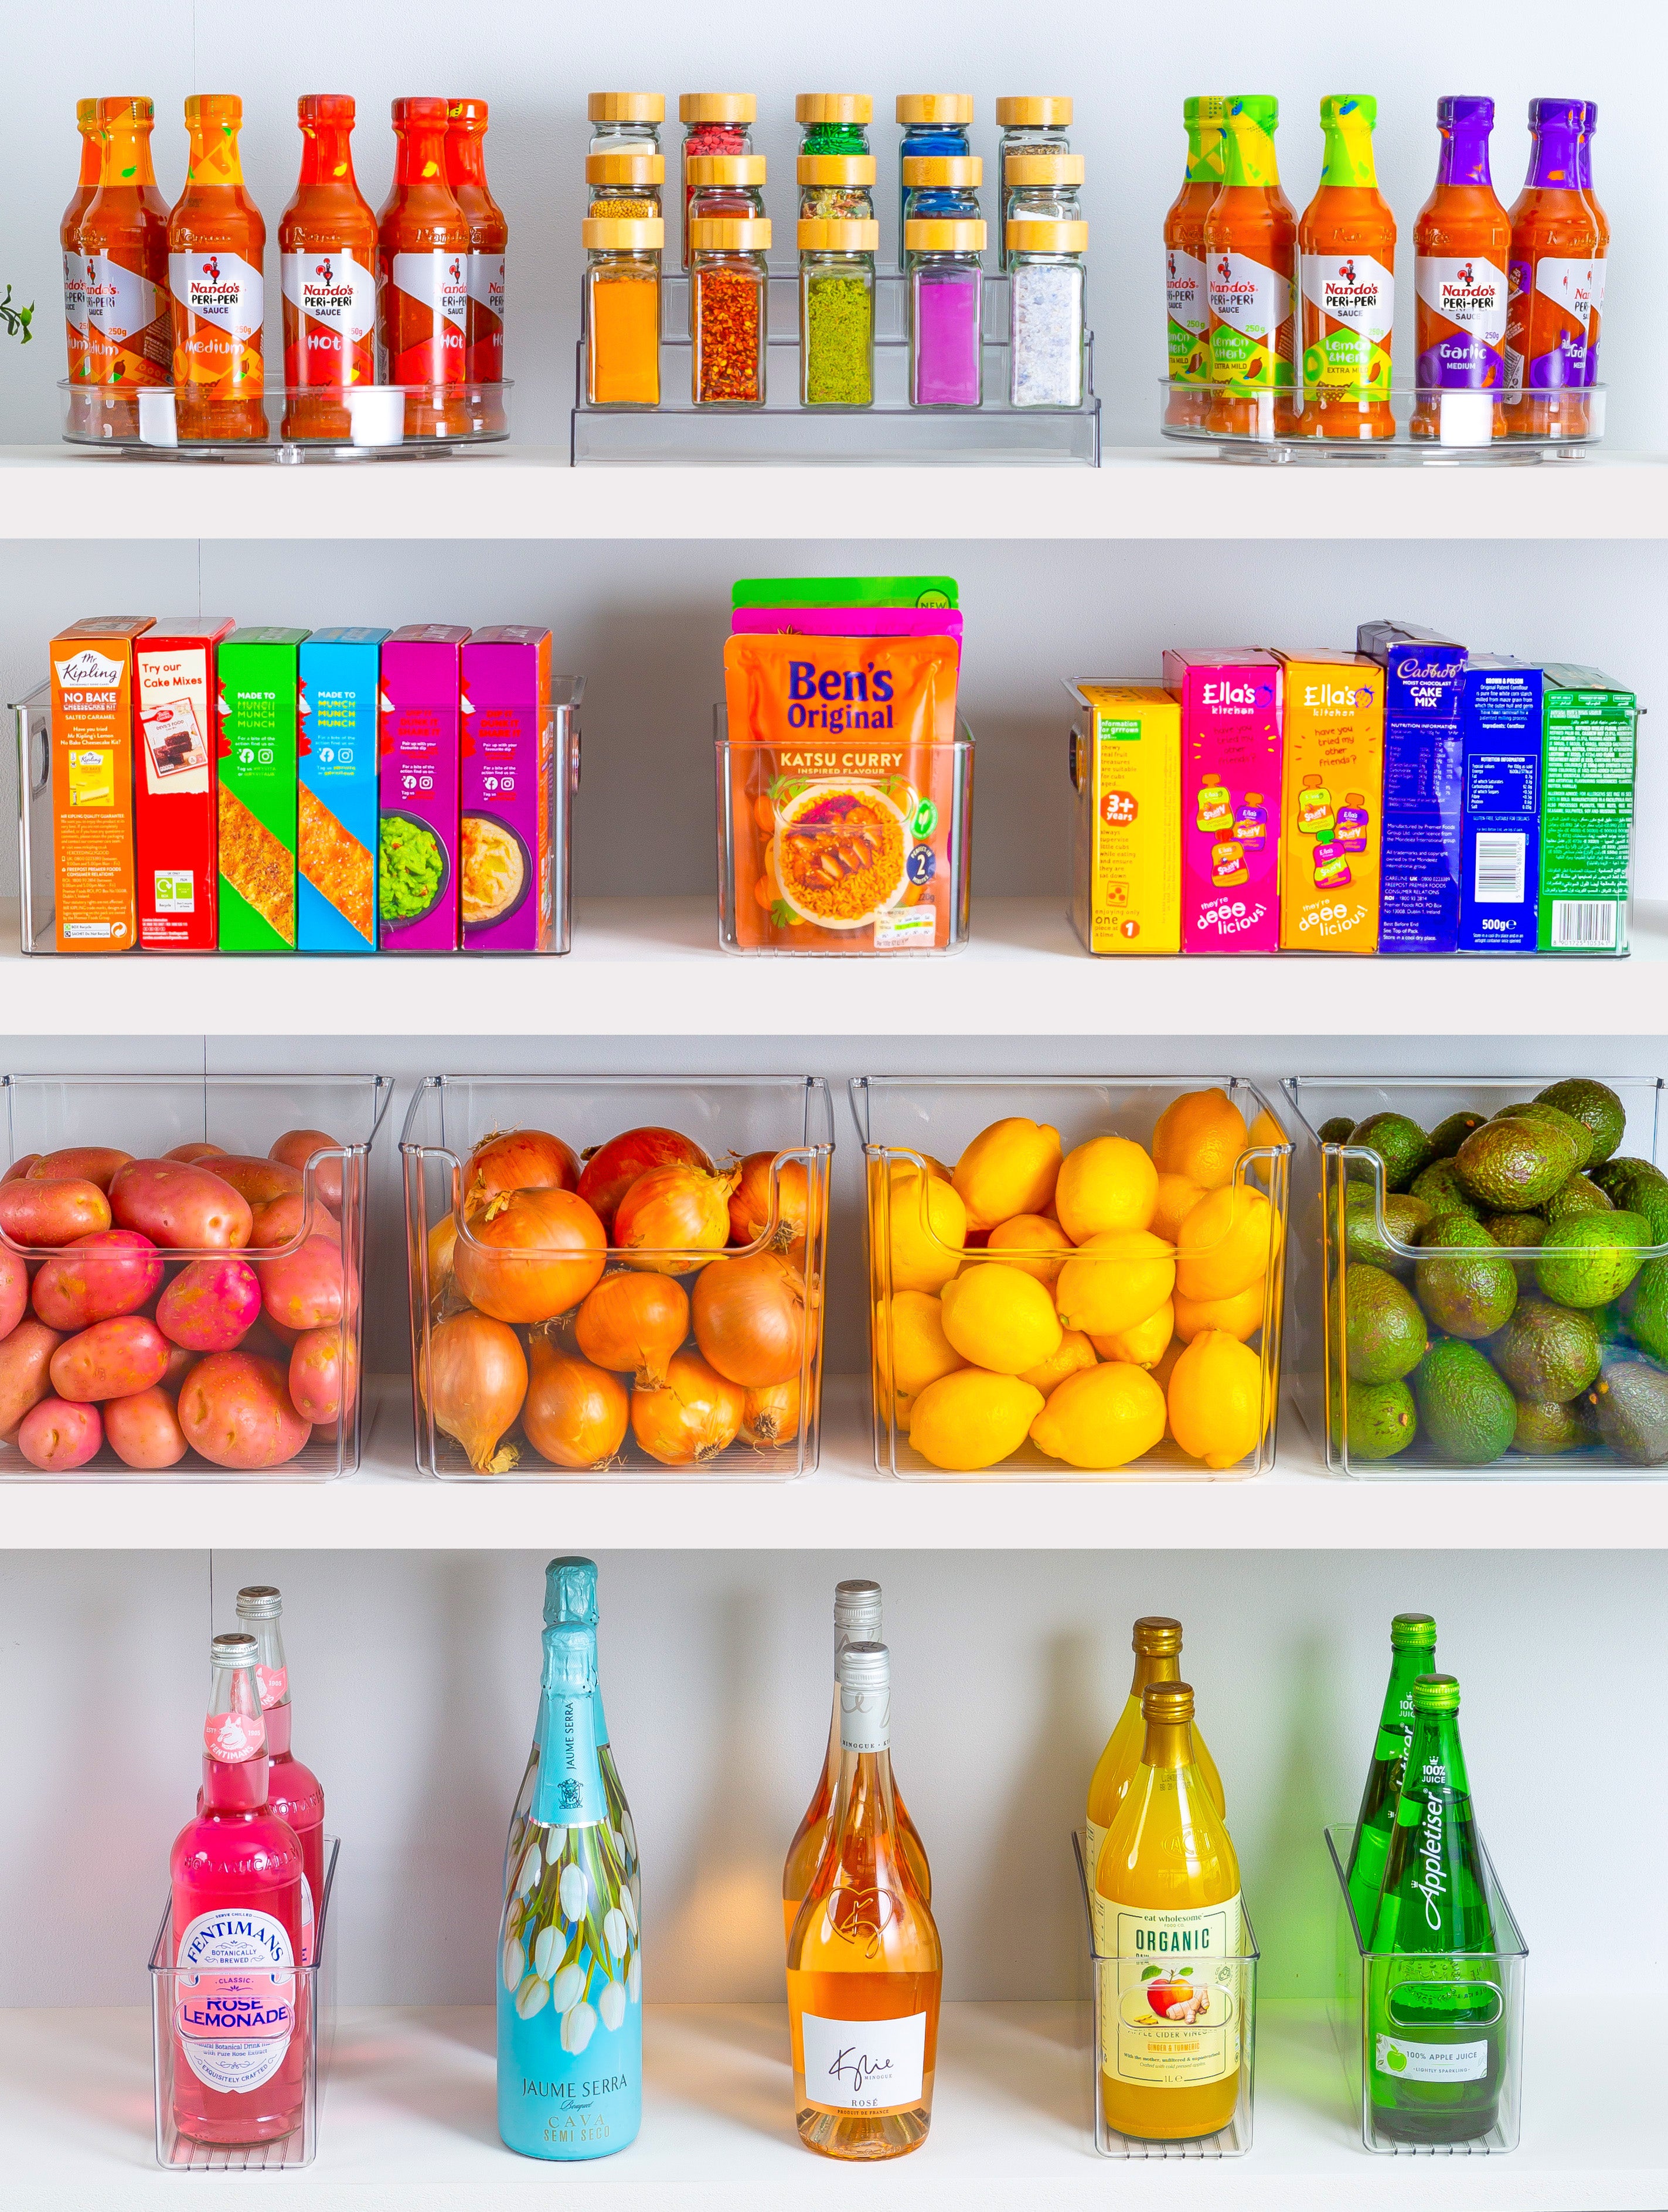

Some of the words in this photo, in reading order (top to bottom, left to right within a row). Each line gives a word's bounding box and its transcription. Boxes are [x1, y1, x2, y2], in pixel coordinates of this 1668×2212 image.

[190, 282, 240, 294] Nando's
[303, 284, 354, 296] Nando's
[1210, 282, 1256, 293] Nando's
[1325, 282, 1379, 295] Nando's
[1441, 285, 1496, 296] Nando's
[235, 326, 252, 335] 250g
[1186, 320, 1206, 329] 250g
[1245, 325, 1265, 334] 250g
[108, 327, 127, 337] 250g
[1369, 328, 1384, 337] 250g
[1485, 332, 1499, 340] 250g
[185, 339, 245, 355] Medium
[1213, 336, 1249, 347] Lemon
[1325, 339, 1371, 351] Lemon
[1439, 343, 1487, 359] Garlic
[81, 653, 97, 663] Mr
[62, 663, 117, 683] Kipling
[142, 664, 161, 674] Try
[163, 663, 182, 672] our
[144, 678, 170, 688] Cake
[173, 676, 202, 686] Mixes
[788, 661, 894, 702] Ben's
[64, 692, 83, 703] NO
[86, 692, 116, 703] BAKE
[1202, 681, 1256, 704] Ella's
[1303, 683, 1356, 707] Ella's
[1410, 687, 1442, 697] CAKE
[318, 700, 356, 708] MUNCH
[1415, 697, 1437, 707] MIX
[1211, 705, 1254, 715] kitchen
[1313, 708, 1355, 717] kitchen
[788, 703, 893, 734] Original
[1314, 728, 1336, 736] have
[1339, 726, 1353, 735] you
[1318, 737, 1340, 746] tried
[1342, 736, 1354, 745] my
[1325, 747, 1348, 755] other
[781, 752, 836, 766] KATSU
[842, 753, 903, 766] CURRY
[1319, 755, 1357, 767] friends?
[1107, 794, 1134, 813] 3+
[1107, 812, 1132, 821] years
[917, 854, 925, 875] 2
[1201, 897, 1228, 911] they're
[1302, 898, 1330, 912] they're
[1095, 916, 1118, 925] one
[1197, 902, 1247, 931] deee
[1217, 903, 1268, 935] licious!
[1298, 904, 1347, 932] deee
[1319, 904, 1369, 936] licious!
[1125, 922, 1134, 936] 1
[1482, 919, 1506, 932] 500g
[565, 1702, 574, 1735] SERRA
[842, 1739, 875, 1749] MINOGUE
[210, 1743, 254, 1760] FENTIMANS
[566, 1736, 575, 1770] JAUME
[1422, 1764, 1446, 1776] 100%
[1421, 1775, 1446, 1784] JUICE
[1419, 1791, 1448, 1931] Appletiser
[187, 1921, 284, 1964] FENTIMANS
[1135, 1928, 1210, 1952] ORGANIC
[206, 1997, 263, 2012] ROSE
[183, 2005, 288, 2028] LEMONADE
[1147, 2043, 1166, 2051] GINGER
[1174, 2043, 1200, 2051] TURMERIC
[1406, 2050, 1427, 2060] 100%
[1429, 2053, 1453, 2061] APPLE
[1455, 2051, 1478, 2060] JUICE
[202, 2064, 240, 2083] EXQUISITELY
[241, 2064, 268, 2082] CRAFTED
[829, 2047, 894, 2092] Kylie
[522, 2078, 576, 2098] JAUME
[582, 2074, 628, 2098] SERRA
[851, 2098, 878, 2107] ROSÉ
[548, 2113, 605, 2128] CAVA
[544, 2129, 574, 2142] SEMI
[581, 2125, 610, 2141] SECO
